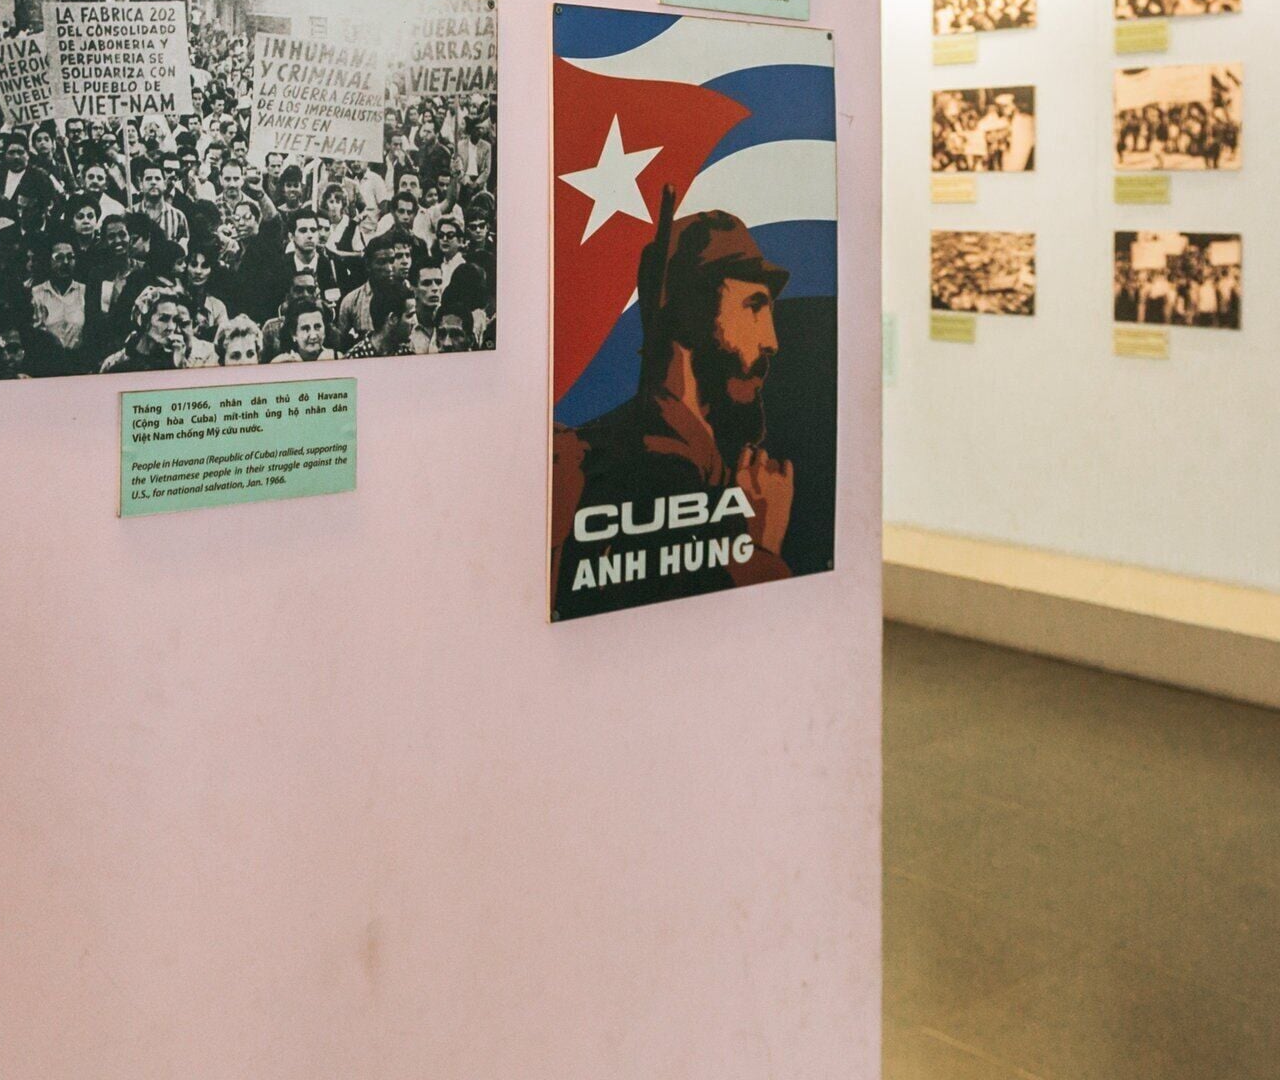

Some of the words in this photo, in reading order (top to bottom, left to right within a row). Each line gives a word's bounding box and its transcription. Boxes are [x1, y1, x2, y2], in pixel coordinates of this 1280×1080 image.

[56, 7, 74, 24] LA
[81, 6, 144, 23] FABRICA
[150, 7, 176, 22] 202
[57, 25, 82, 37] DEL
[86, 24, 176, 37] CONSOLIDADO
[59, 40, 75, 51] DE
[80, 40, 155, 51] JABONERIA
[160, 38, 168, 49] Y
[411, 40, 483, 61] GARRAS
[60, 53, 145, 65] PERFUMERIA
[149, 53, 164, 64] SE
[62, 66, 145, 80] SOLIDARIZA
[150, 65, 176, 78] CON
[260, 60, 274, 78] Y
[277, 62, 372, 90] CRIMINAL
[63, 81, 80, 94] EL
[83, 80, 138, 93] PUEBLO
[144, 80, 161, 92] DE
[259, 82, 277, 97] LA
[282, 84, 337, 102] GUERRA
[72, 92, 175, 116] VIET-NAM
[257, 99, 275, 111] DE
[278, 100, 301, 113] LOS
[304, 103, 383, 122] IMPERIALISTAS
[257, 111, 309, 130] YANKIS
[311, 118, 332, 132] EN
[273, 131, 366, 156] VIET-NAM
[133, 405, 162, 415] Tháng
[171, 401, 211, 411] 01/1966,
[317, 392, 348, 400] Havana
[132, 419, 160, 430] (Cộng
[191, 414, 217, 424] Cuba)
[132, 433, 151, 444] Việt
[153, 432, 174, 441] Nam
[131, 460, 161, 471] People
[162, 459, 170, 468] in
[172, 456, 205, 467] Havana
[206, 452, 244, 465] (Republic
[245, 451, 254, 460] of
[254, 448, 278, 459] Cuba)
[279, 446, 304, 457] rallied,
[306, 443, 348, 456] supporting
[131, 476, 146, 486] the
[150, 471, 200, 484] Vietnamese
[203, 468, 231, 480] people
[235, 466, 243, 475] in
[246, 464, 265, 474] their
[268, 460, 300, 472] struggle
[303, 457, 332, 469] against
[335, 456, 348, 465] the
[152, 488, 165, 498] for
[166, 483, 204, 496] national
[204, 480, 245, 493] salvation,
[246, 479, 263, 488] Jan.
[266, 475, 287, 485] 1966.
[574, 486, 756, 543] CUBA
[572, 549, 647, 592] ANH
[660, 534, 755, 577] HÙNG
